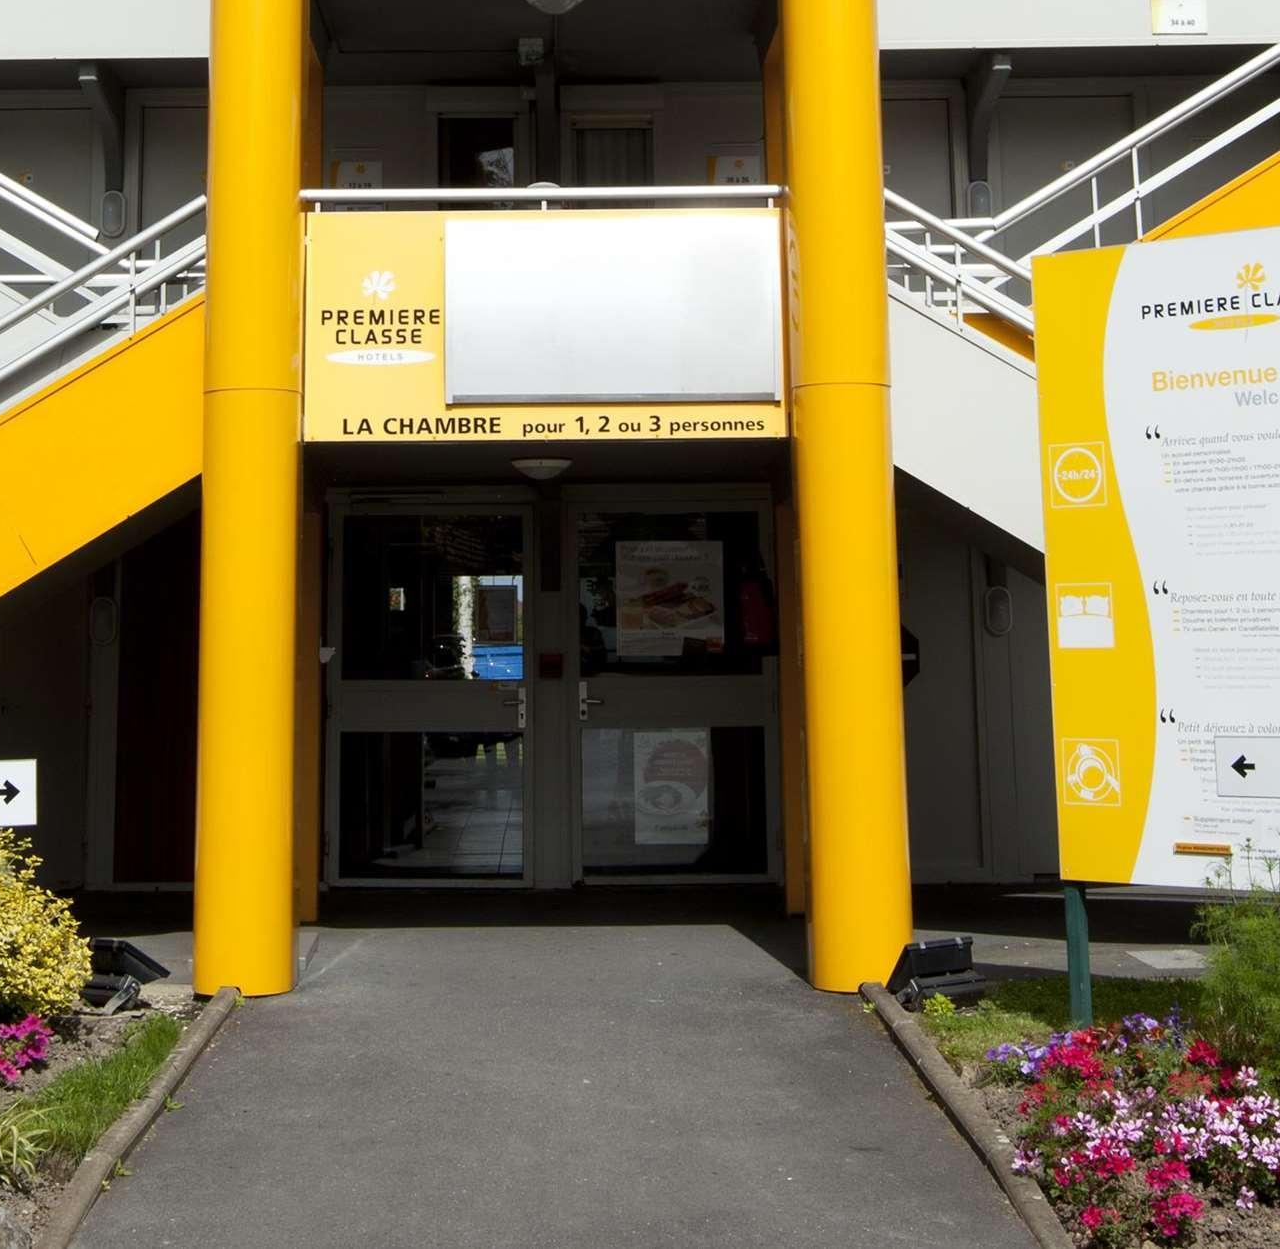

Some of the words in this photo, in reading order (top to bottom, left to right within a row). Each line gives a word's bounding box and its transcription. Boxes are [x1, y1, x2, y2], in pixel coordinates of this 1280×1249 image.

[1141, 295, 1241, 320] PREMIERE
[321, 309, 441, 326] PREMIERE
[335, 328, 422, 345] CLASSE
[357, 353, 404, 362] HOTELS
[1151, 368, 1278, 392] Bienvenue
[341, 417, 374, 436] LA
[382, 415, 502, 436] CHAMBRE
[521, 419, 567, 439] pour
[574, 415, 591, 437] 1,
[597, 415, 611, 434] 2
[617, 418, 642, 434] ou
[648, 415, 662, 433] 3
[668, 417, 766, 437] personnes
[1199, 432, 1229, 448] quand
[1231, 433, 1255, 443] vous
[1236, 592, 1248, 602] en
[1251, 590, 1277, 602] toute
